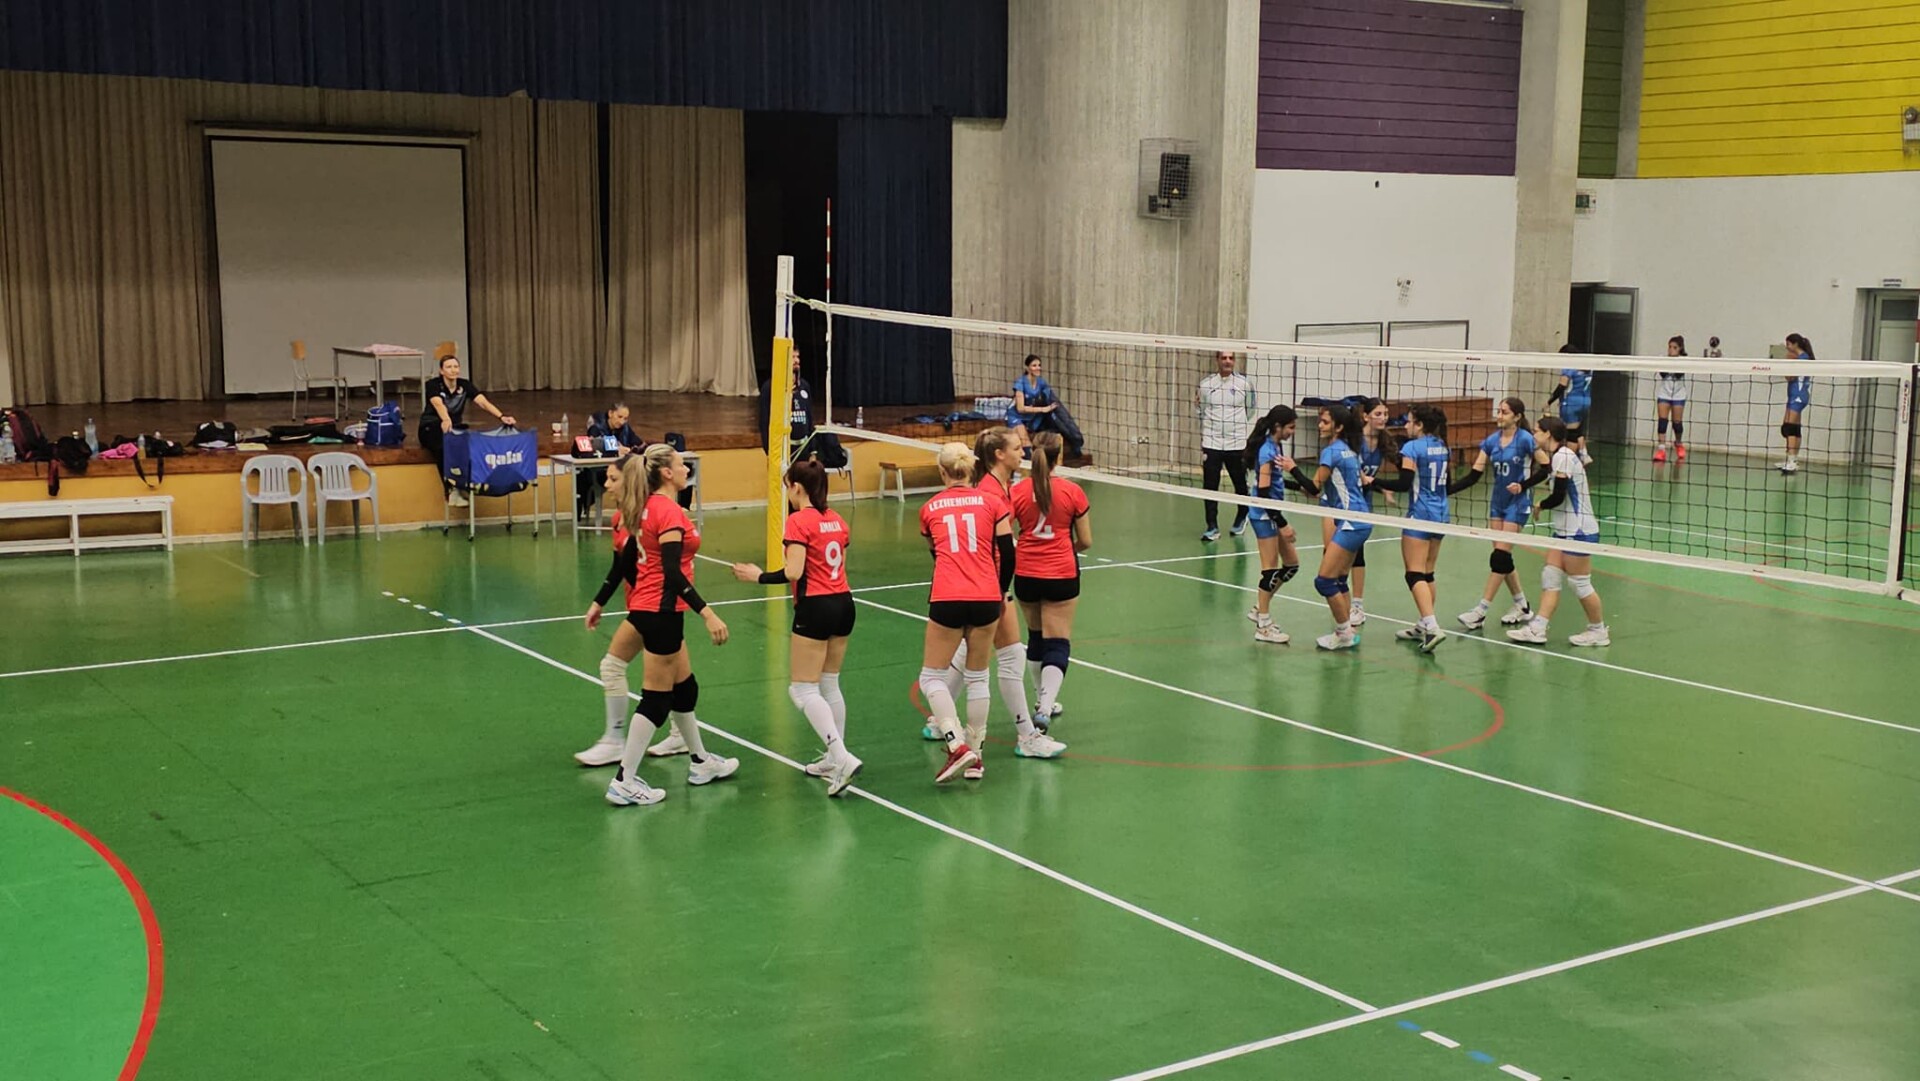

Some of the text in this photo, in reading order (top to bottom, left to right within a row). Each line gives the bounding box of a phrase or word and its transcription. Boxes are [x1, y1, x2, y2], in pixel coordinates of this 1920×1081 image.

[485, 450, 523, 469] gala
[942, 512, 978, 553] 11
[825, 540, 843, 580] 9
